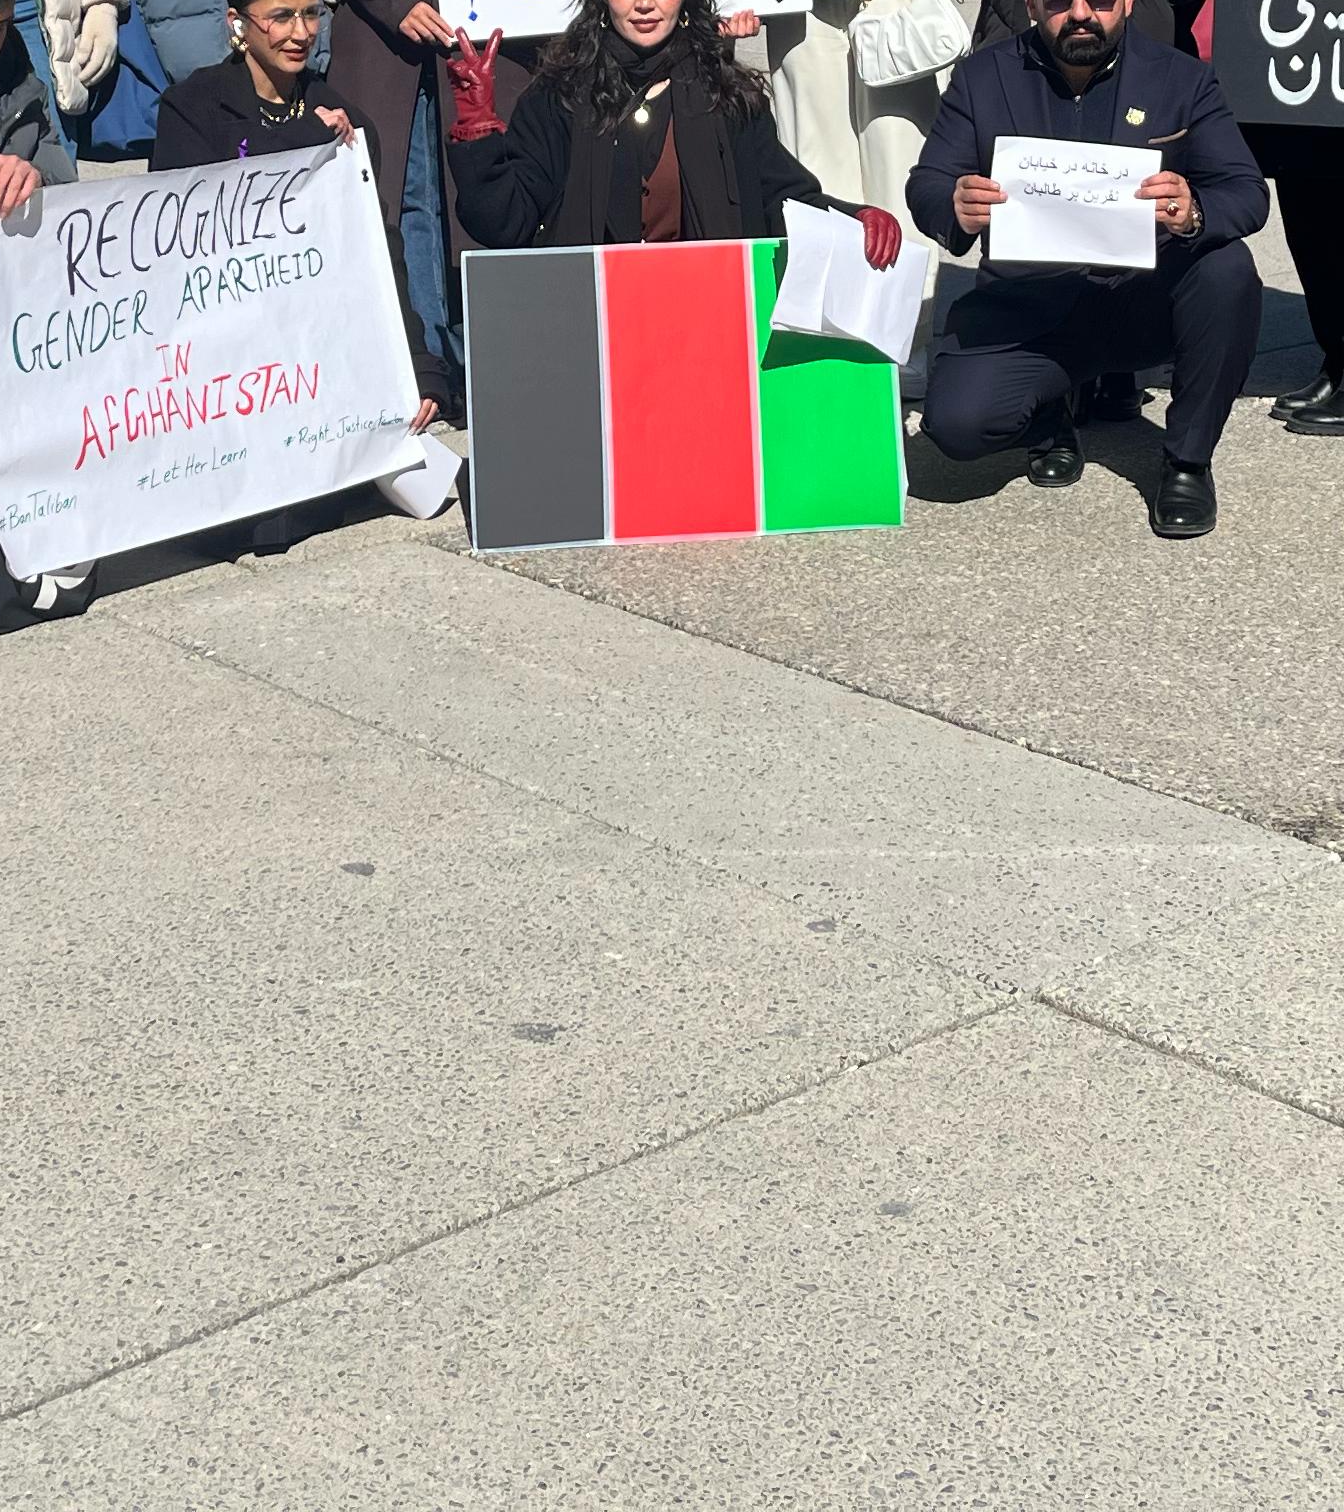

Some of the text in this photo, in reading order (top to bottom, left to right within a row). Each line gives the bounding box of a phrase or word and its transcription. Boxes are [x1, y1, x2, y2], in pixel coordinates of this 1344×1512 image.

[57, 168, 310, 296] RECOGNIZE
[12, 247, 323, 373] GENDER APARTHEID
[156, 340, 191, 382] IN
[74, 363, 318, 470] AFGHANISTAN
